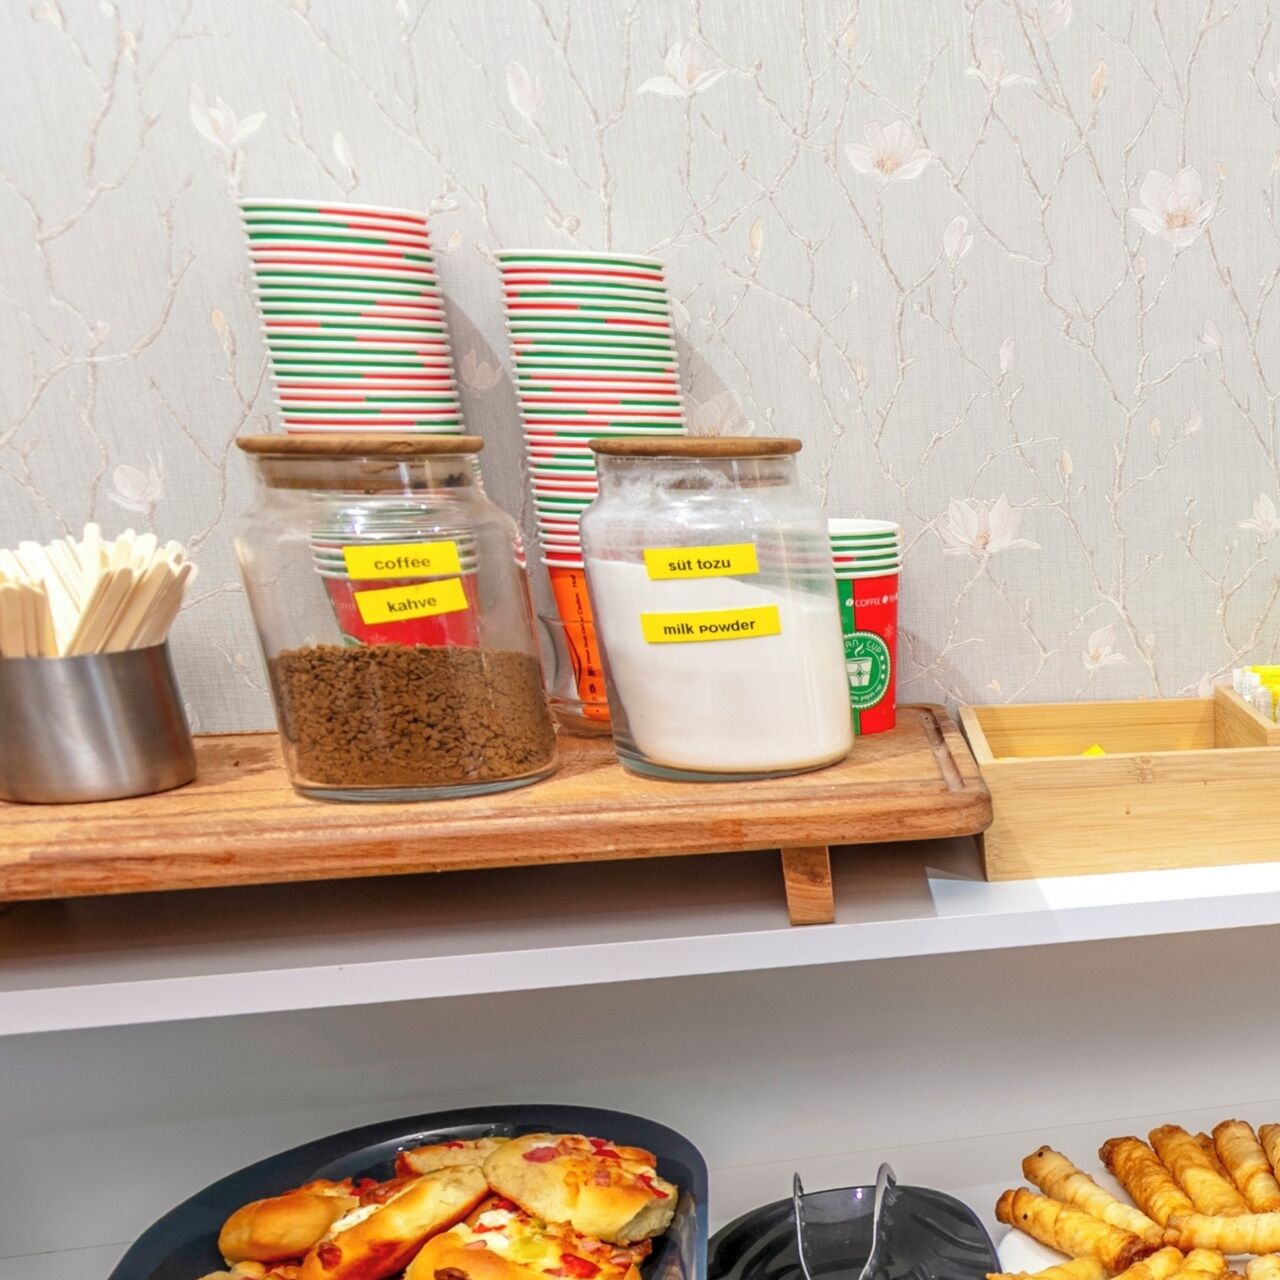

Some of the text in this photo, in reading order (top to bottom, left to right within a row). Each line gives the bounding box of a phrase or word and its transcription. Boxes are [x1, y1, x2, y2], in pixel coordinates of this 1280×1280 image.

[374, 556, 432, 571] coffee
[667, 558, 732, 572] süt tozu
[387, 596, 438, 613] kahve
[663, 620, 756, 635] milk powder
